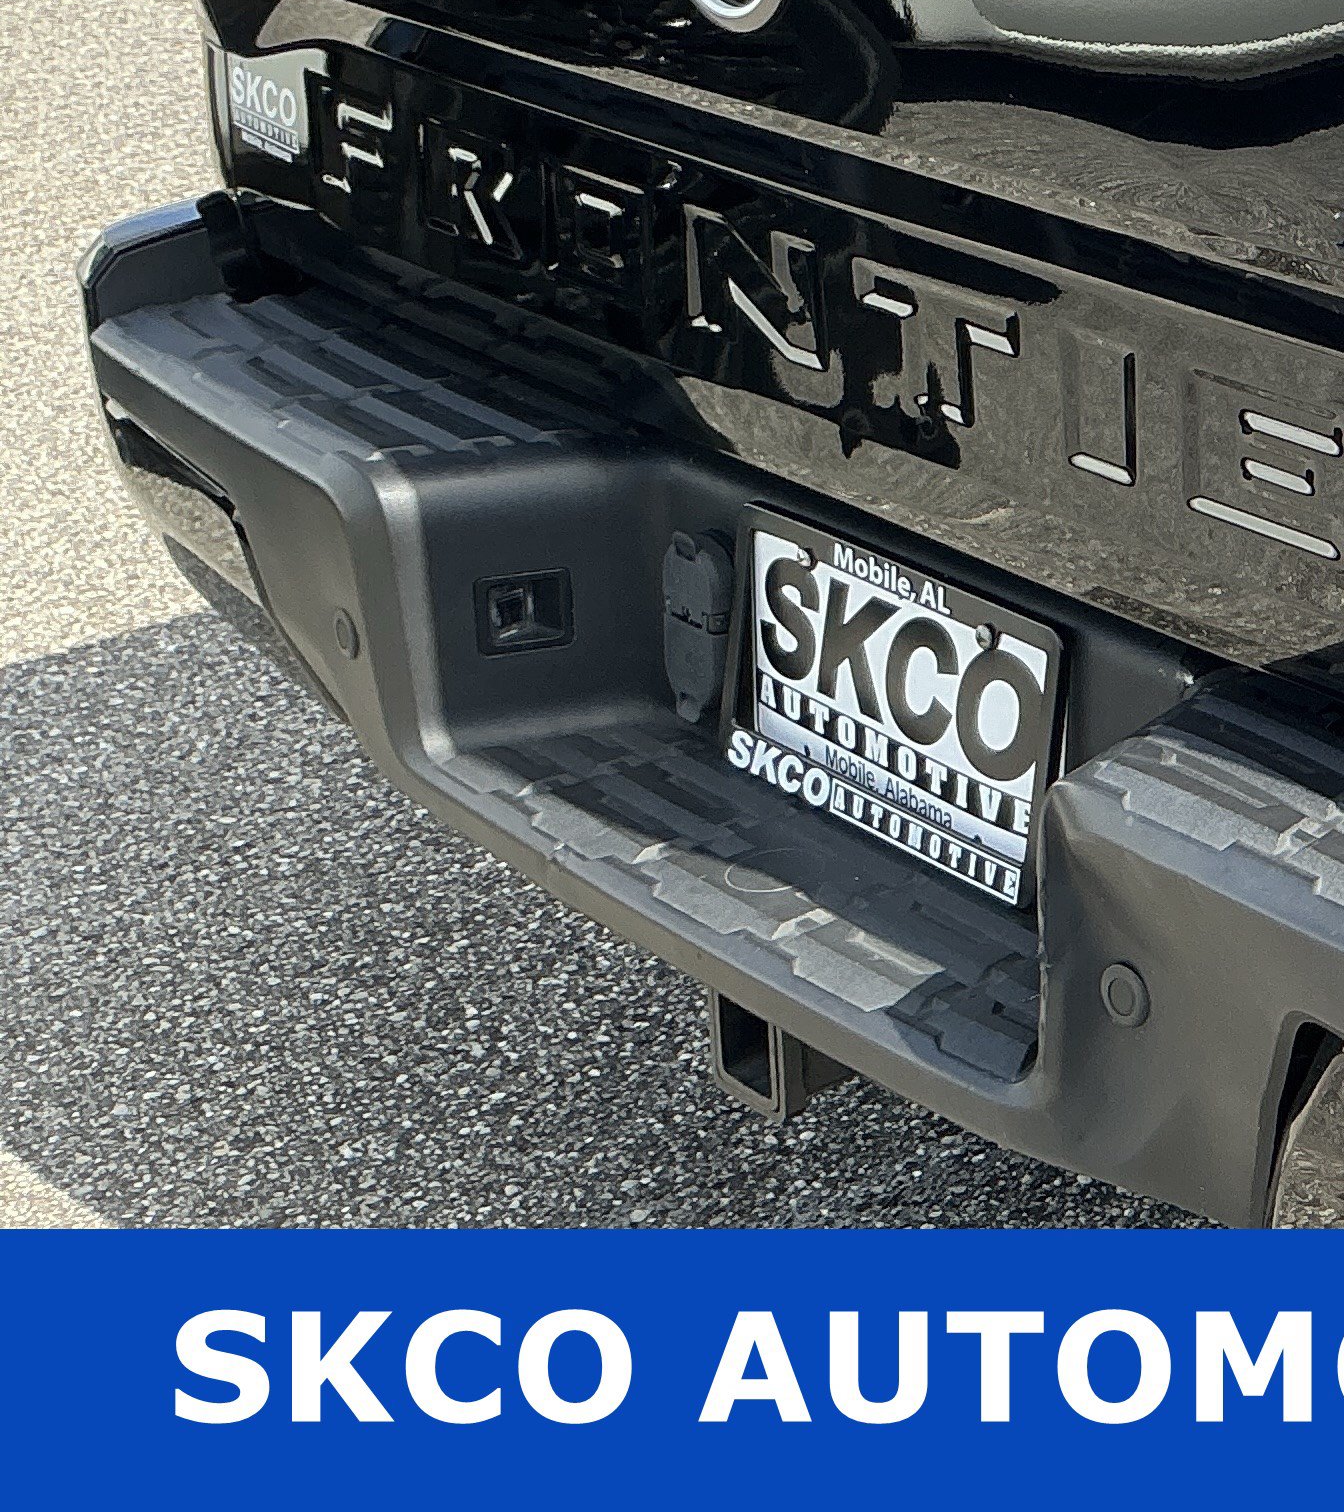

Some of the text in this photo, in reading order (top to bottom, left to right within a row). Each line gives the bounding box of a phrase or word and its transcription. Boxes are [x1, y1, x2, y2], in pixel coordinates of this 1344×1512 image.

[232, 66, 297, 127] SKCO
[760, 556, 1046, 782] SKCO
[727, 730, 831, 807] SKCO
[760, 673, 1032, 835] AUTOMOTIVE
[834, 787, 1019, 899] AUTOMOTIVE
[884, 779, 954, 830] Alabama
